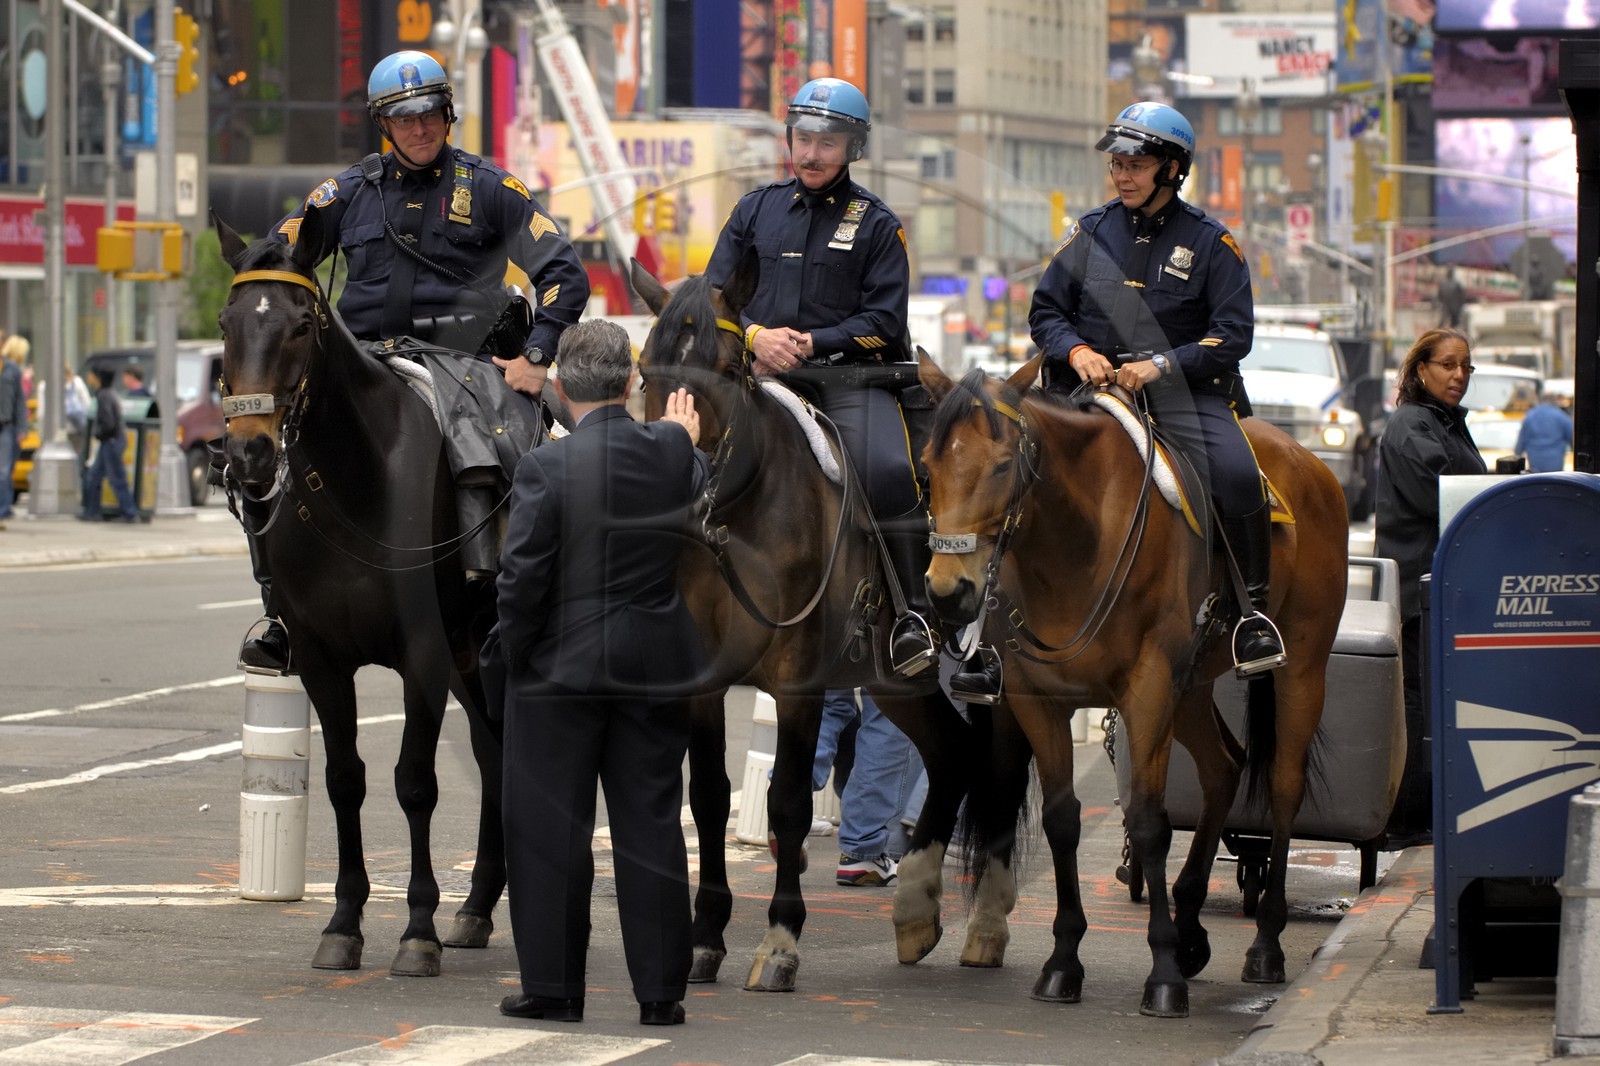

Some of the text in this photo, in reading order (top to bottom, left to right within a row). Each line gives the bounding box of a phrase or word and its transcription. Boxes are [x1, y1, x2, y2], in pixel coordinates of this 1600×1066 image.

[1259, 35, 1316, 57] NANCY
[617, 137, 695, 167] ARING
[231, 398, 262, 412] 3519
[1500, 574, 1600, 594] EXPRESS
[1495, 597, 1553, 615] MAIL
